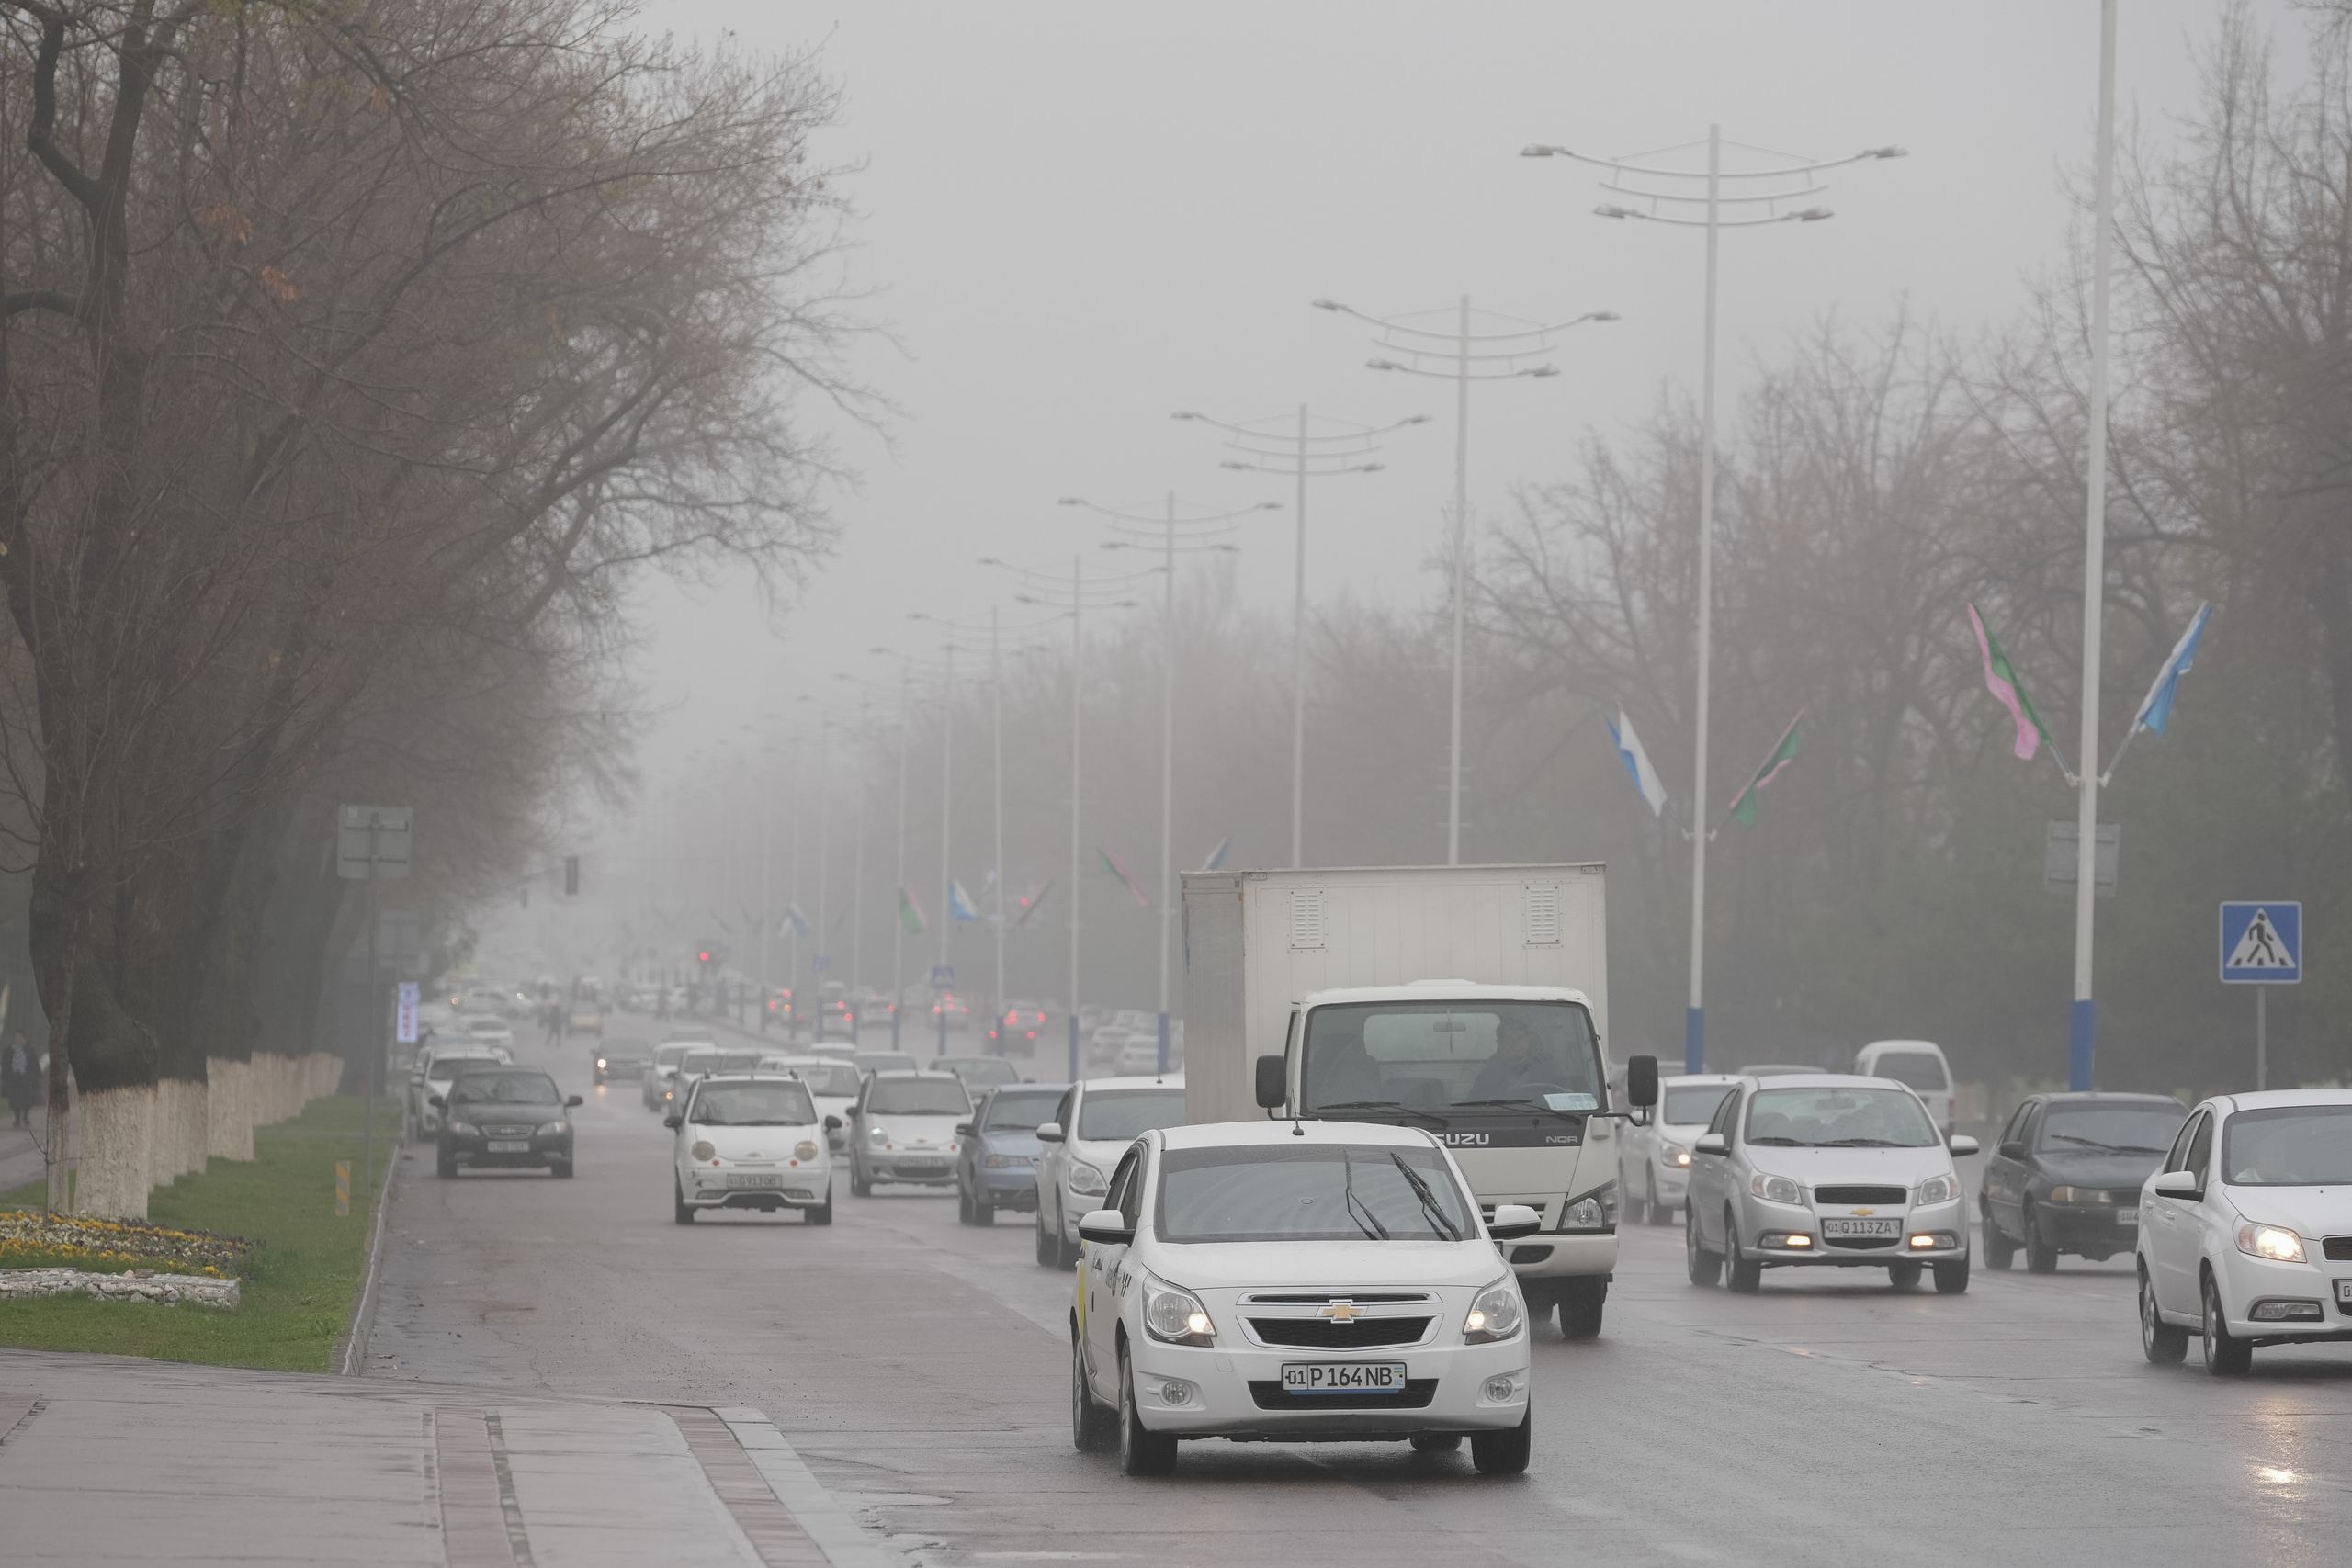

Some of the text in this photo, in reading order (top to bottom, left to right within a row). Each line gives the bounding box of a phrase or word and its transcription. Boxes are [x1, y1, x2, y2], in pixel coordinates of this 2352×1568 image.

[1434, 1134, 1489, 1145] SUZU
[1827, 1223, 1838, 1232] 01
[1288, 1370, 1306, 1384] 01
